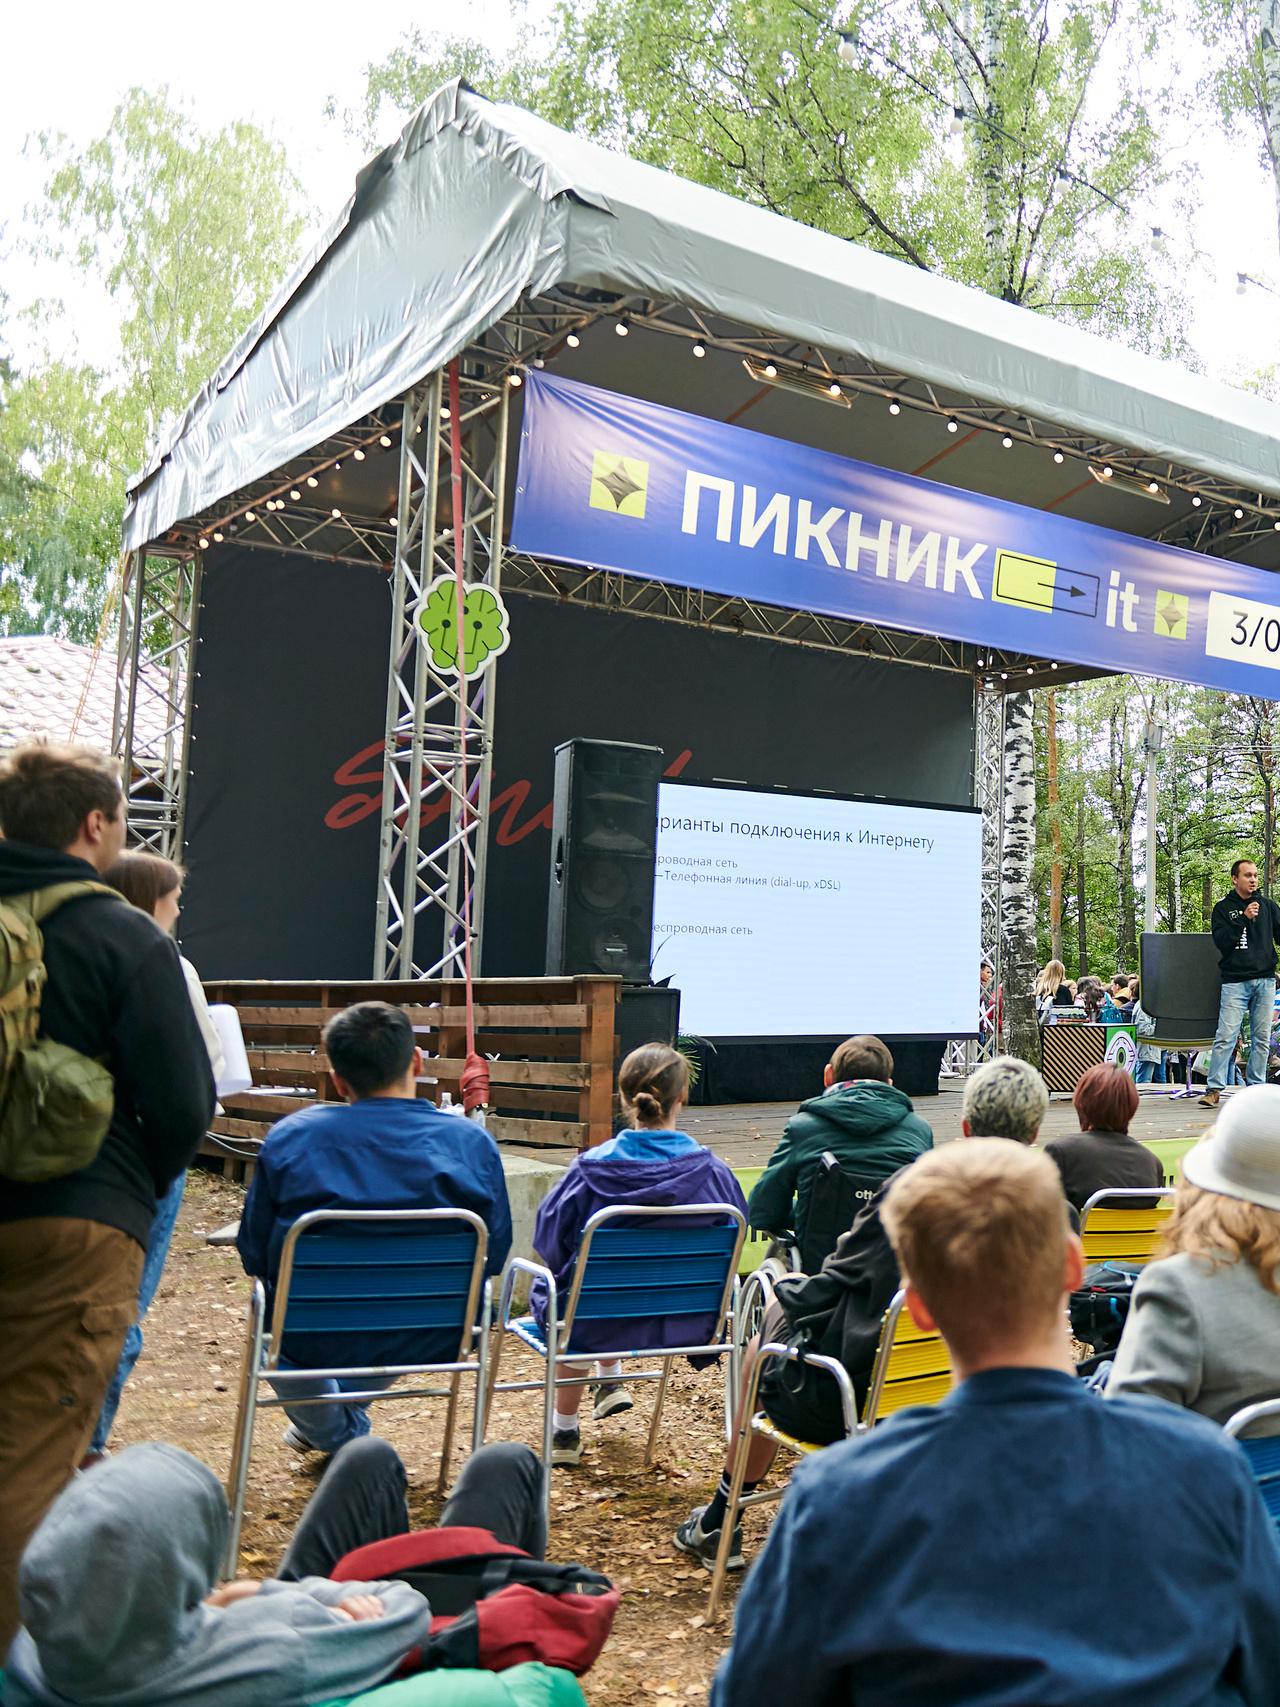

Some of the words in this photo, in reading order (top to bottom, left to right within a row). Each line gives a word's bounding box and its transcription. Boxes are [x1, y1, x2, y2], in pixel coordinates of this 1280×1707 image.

[681, 469, 989, 601] ПИКНИК
[1106, 569, 1139, 633] it
[658, 816, 724, 833] рианты
[730, 822, 840, 842] подключения
[846, 831, 853, 843] к
[858, 830, 934, 853] Интернету
[657, 855, 712, 867] роводная
[715, 858, 738, 869] сеть
[735, 876, 768, 886] линия
[770, 876, 811, 890] (dial-up,
[814, 879, 842, 891] xDSL)
[653, 924, 727, 935] еспроводная
[730, 926, 753, 935] сеть
[855, 1189, 874, 1200] ott
